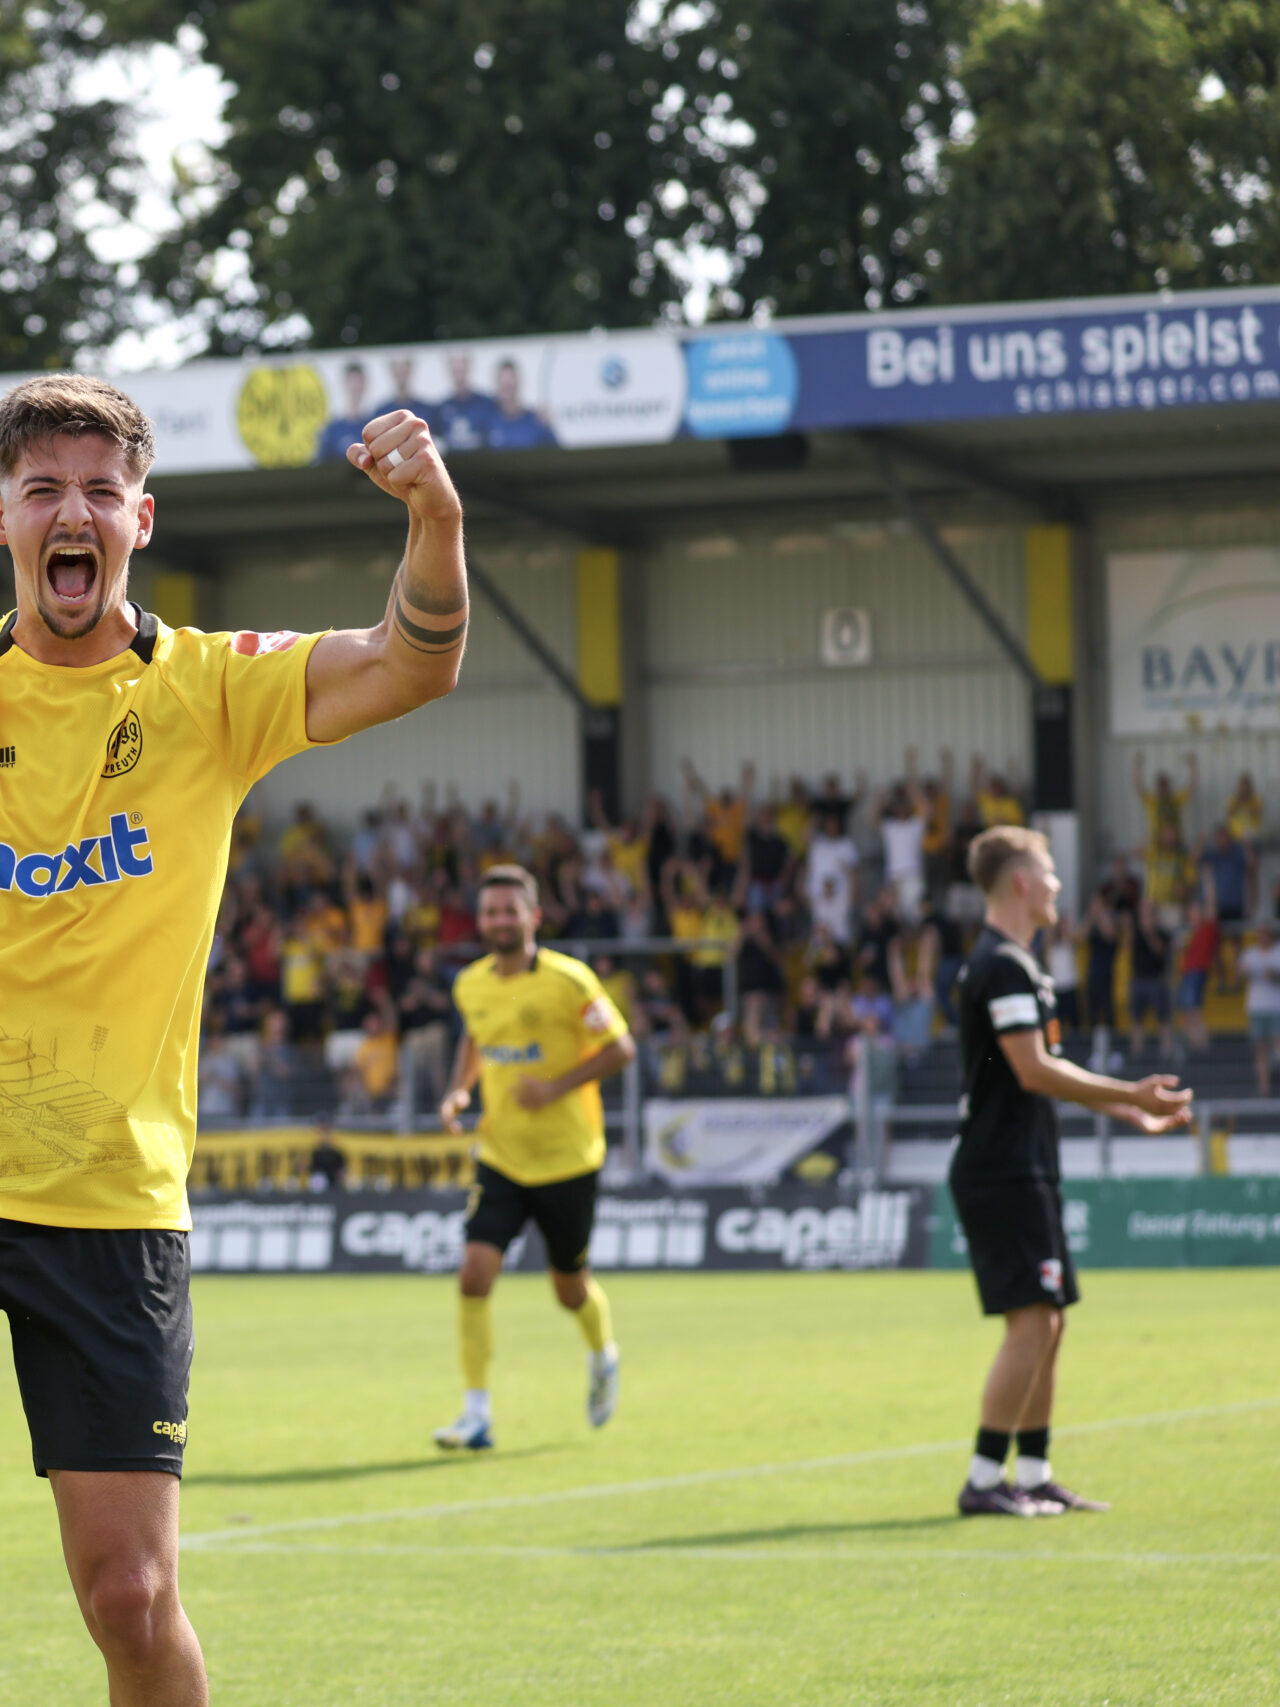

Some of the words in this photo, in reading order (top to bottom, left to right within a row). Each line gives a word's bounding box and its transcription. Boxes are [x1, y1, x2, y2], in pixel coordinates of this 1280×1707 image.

[866, 325, 954, 387] Bei
[969, 329, 1067, 381] uns
[1081, 304, 1264, 378] spielst
[340, 1211, 467, 1268] cape
[716, 1191, 910, 1266] capelli
